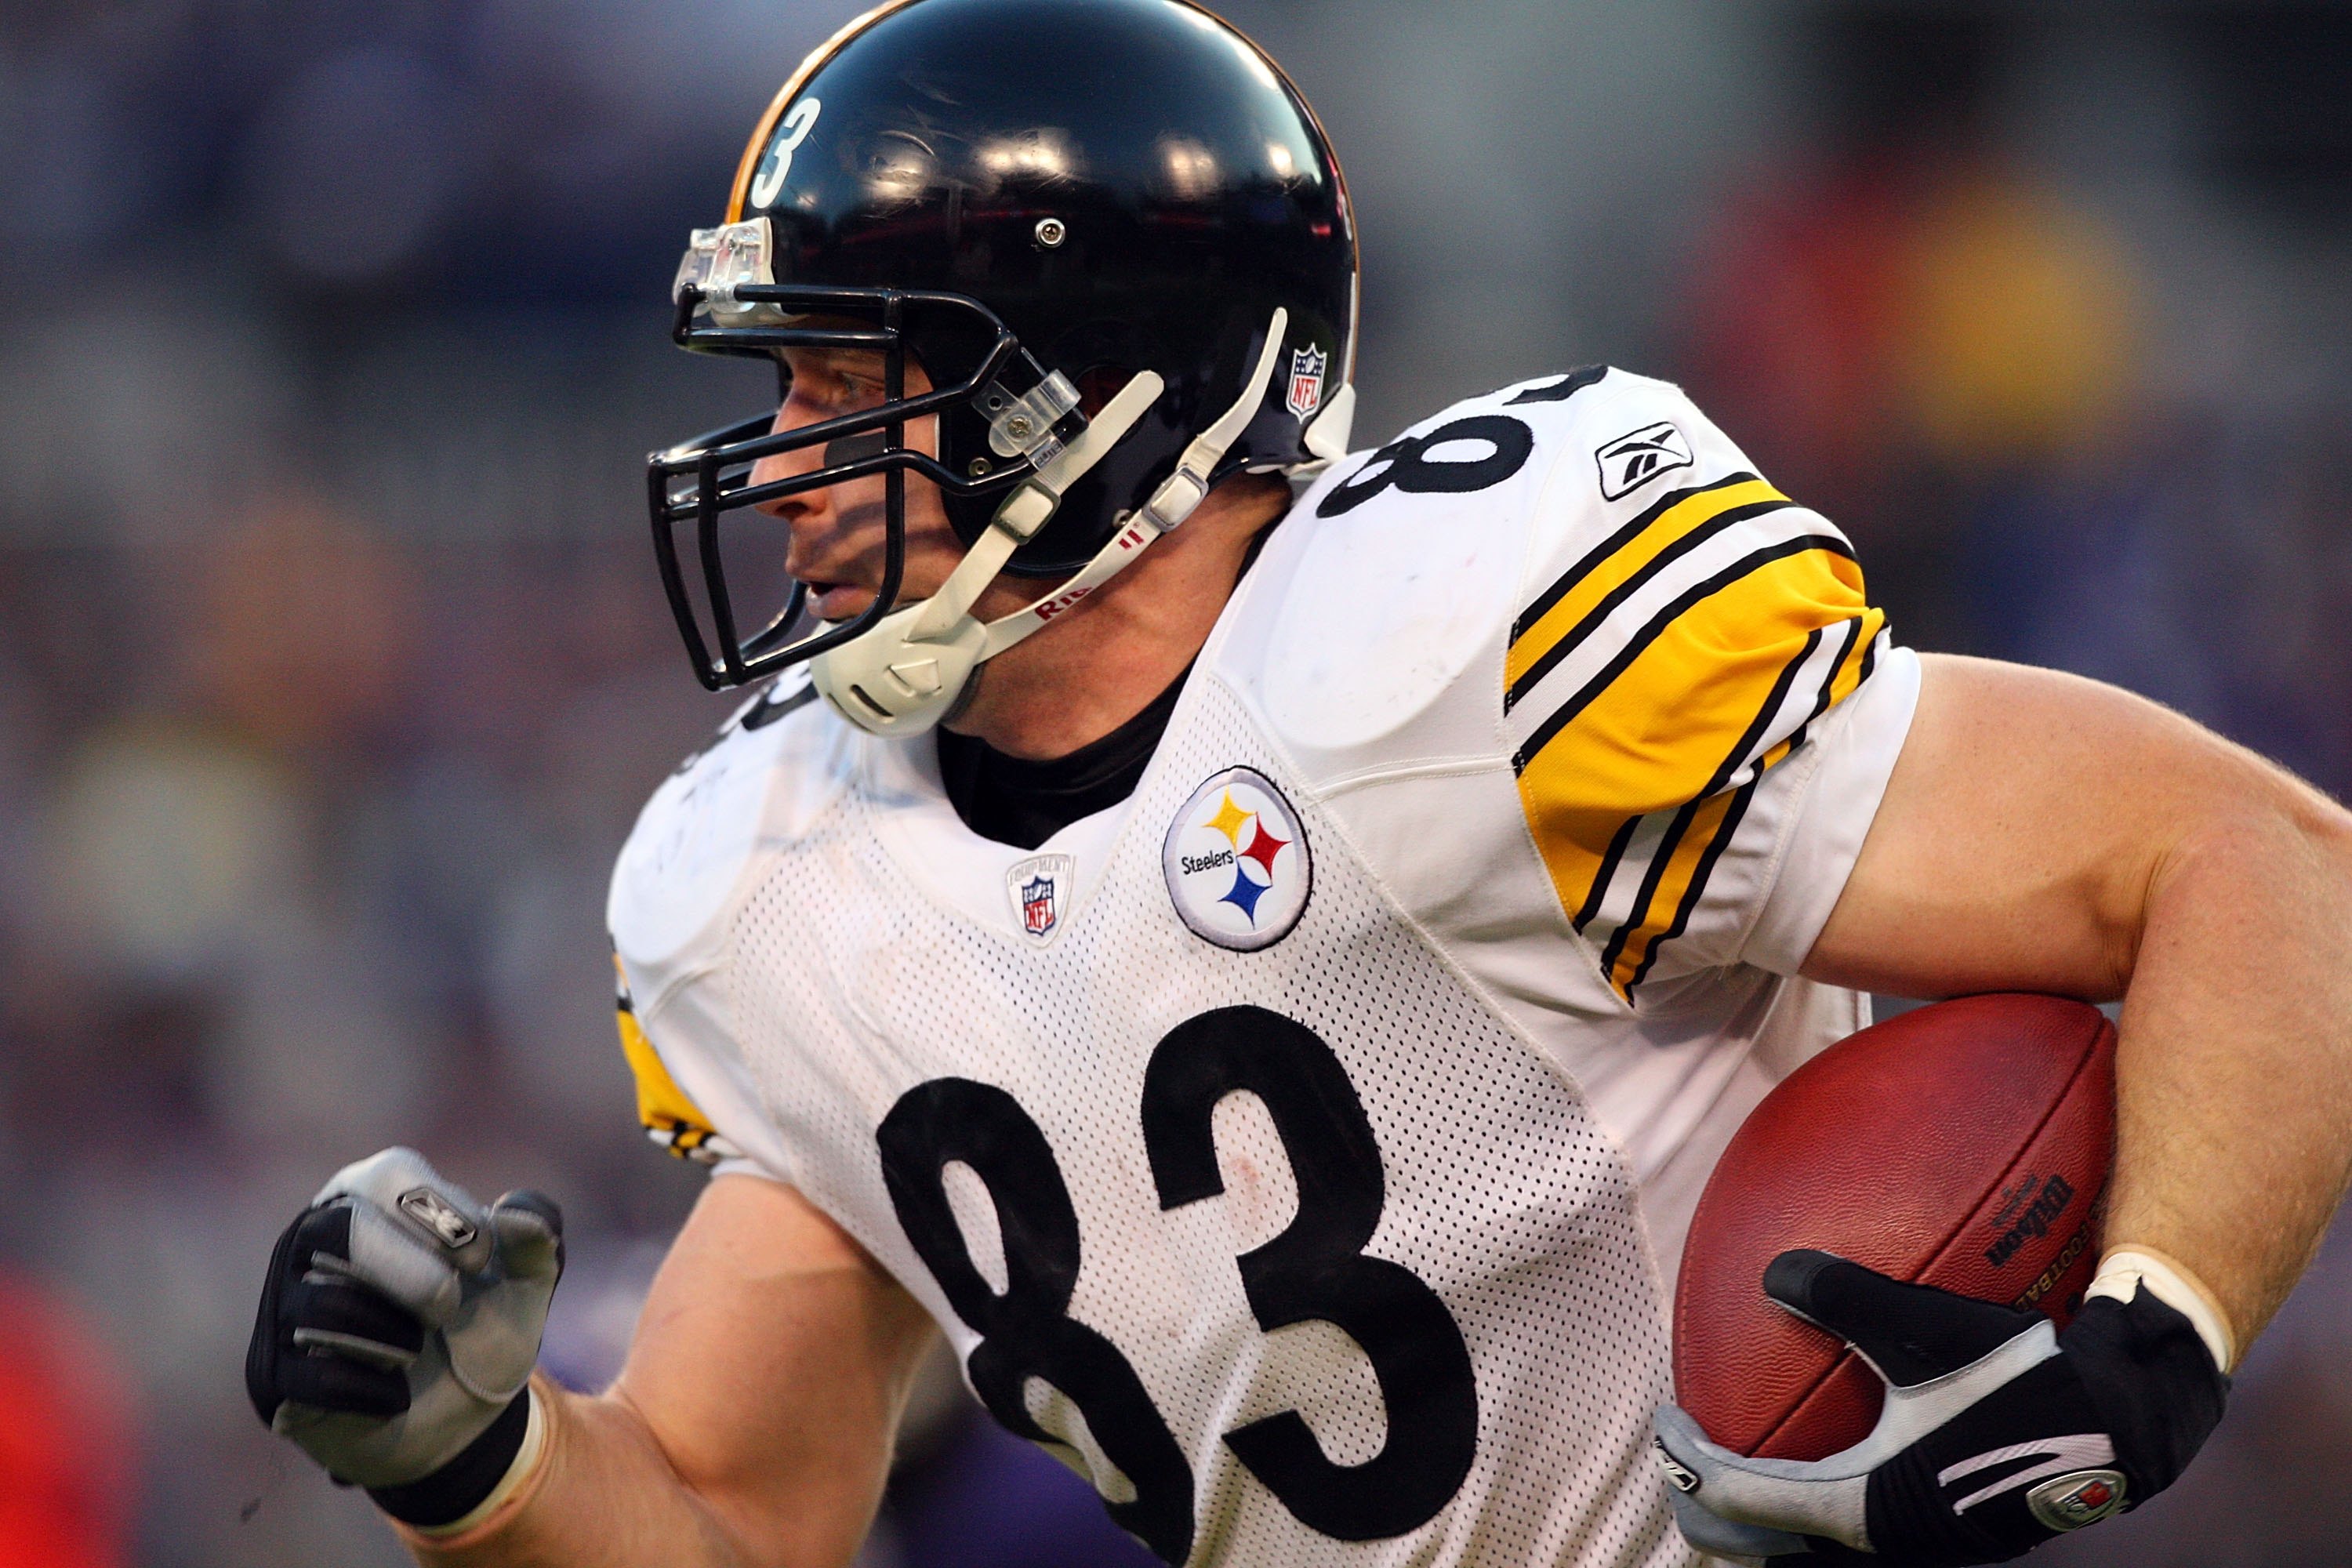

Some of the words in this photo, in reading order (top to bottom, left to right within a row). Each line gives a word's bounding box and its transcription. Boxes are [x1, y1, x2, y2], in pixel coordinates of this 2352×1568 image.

[751, 97, 822, 209] 3
[1293, 377, 1317, 409] NFL
[1181, 850, 1234, 875] Steelers
[1025, 899, 1054, 929] NFL
[1985, 1174, 2075, 1268] Wilson
[876, 1004, 1479, 1568] 83
